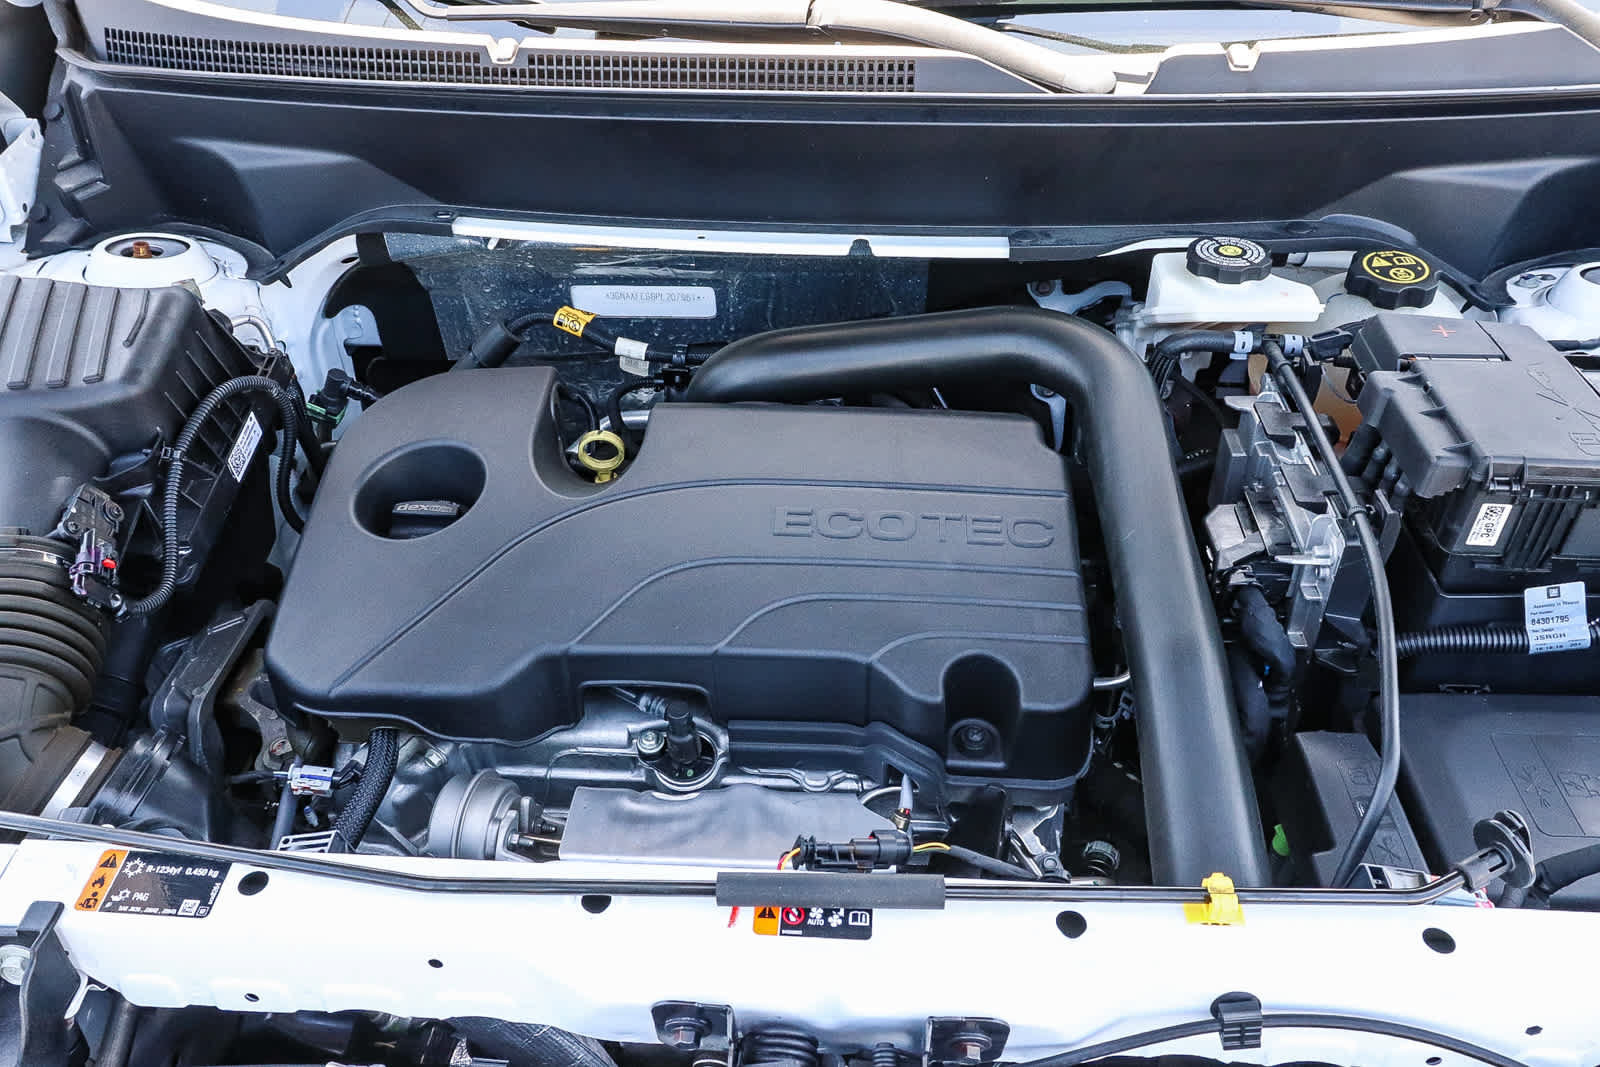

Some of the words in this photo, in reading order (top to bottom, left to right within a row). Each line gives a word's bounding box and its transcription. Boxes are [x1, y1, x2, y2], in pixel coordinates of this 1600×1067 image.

[772, 505, 1055, 549] ECOTEC
[1531, 614, 1569, 625] 84301795
[146, 865, 182, 875] R-1234yf
[185, 867, 208, 877] 0.450
[208, 869, 220, 879] kg
[132, 892, 149, 902] PAG
[807, 918, 824, 926] AUTO
